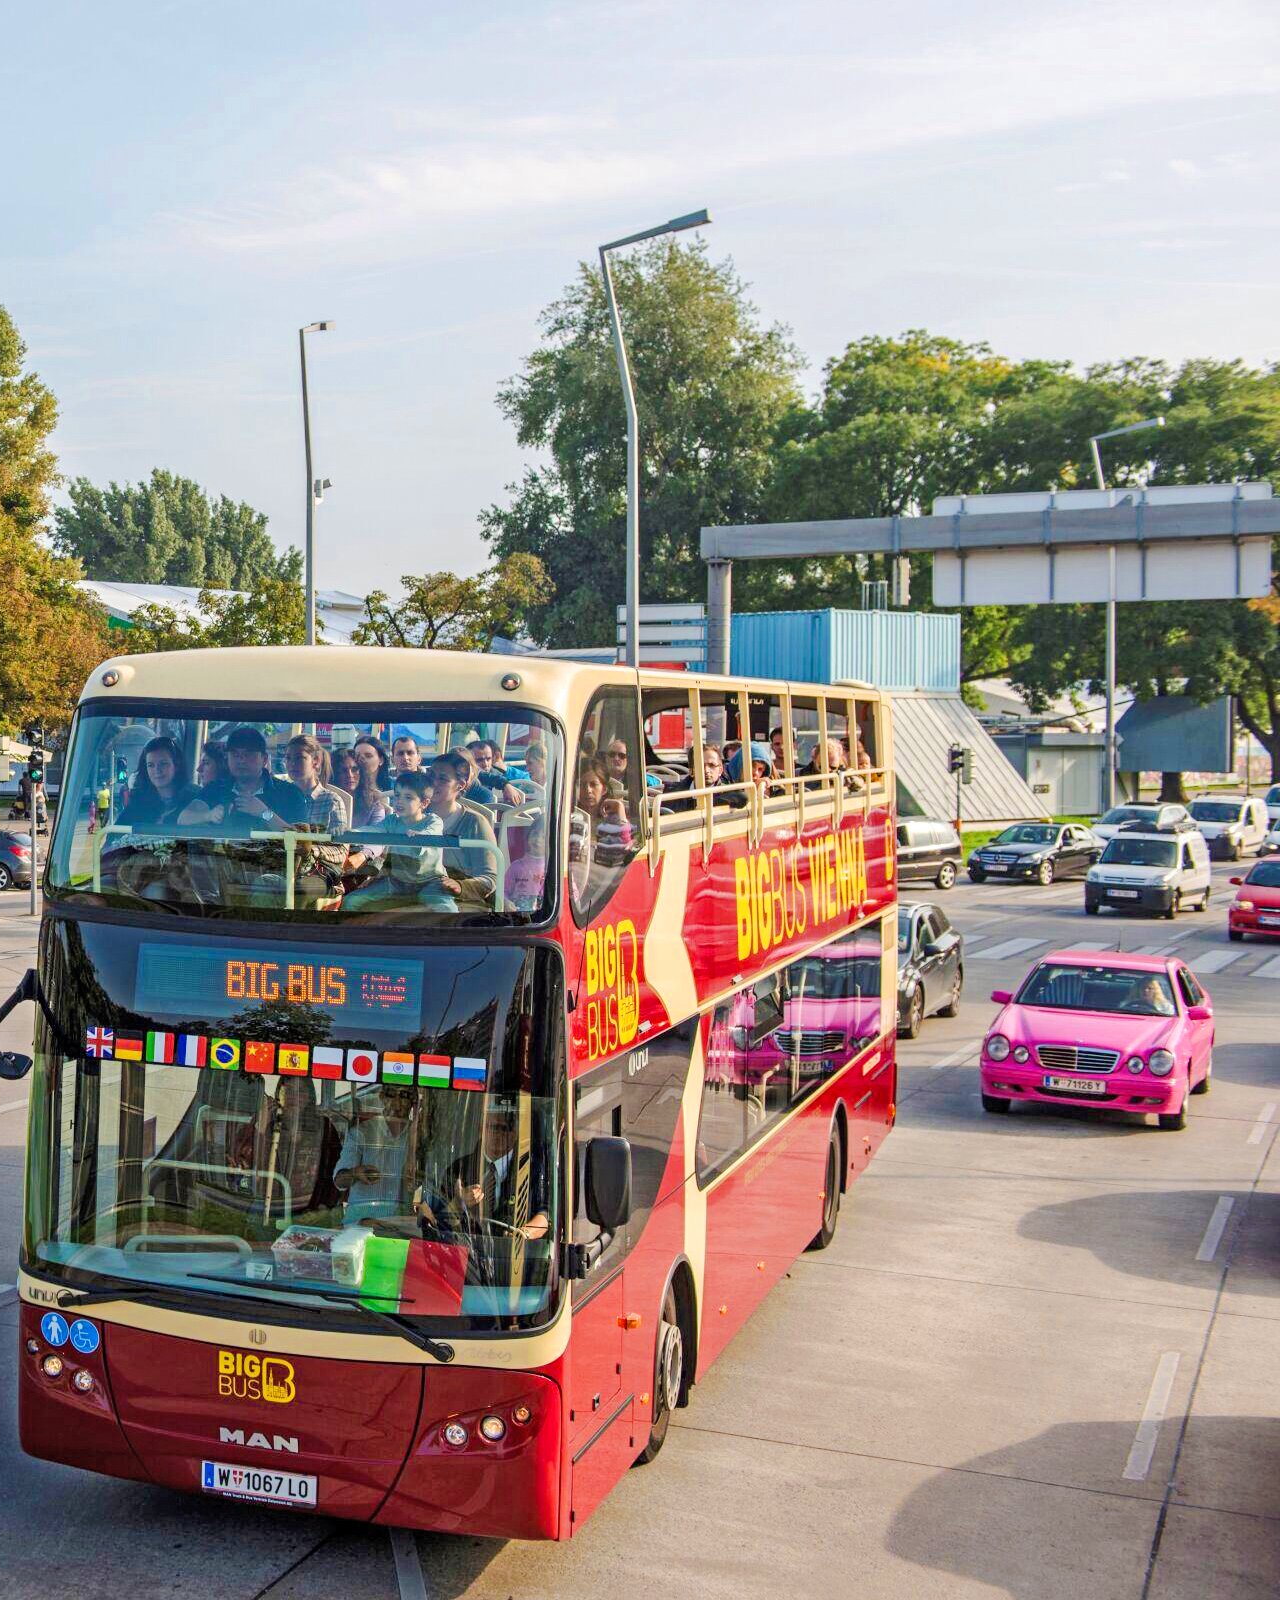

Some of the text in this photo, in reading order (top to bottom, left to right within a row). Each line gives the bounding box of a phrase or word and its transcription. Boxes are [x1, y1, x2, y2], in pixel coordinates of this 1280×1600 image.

[808, 825, 868, 926] VIENNA
[586, 924, 616, 997] BIG
[227, 961, 279, 1000] BIG
[288, 965, 346, 1005] BUS
[587, 993, 618, 1062] BUS
[219, 1350, 261, 1378] BIG
[219, 1374, 261, 1400] BUS
[219, 1426, 299, 1454] MAN
[218, 1468, 230, 1486] W
[244, 1472, 284, 1494] 1067
